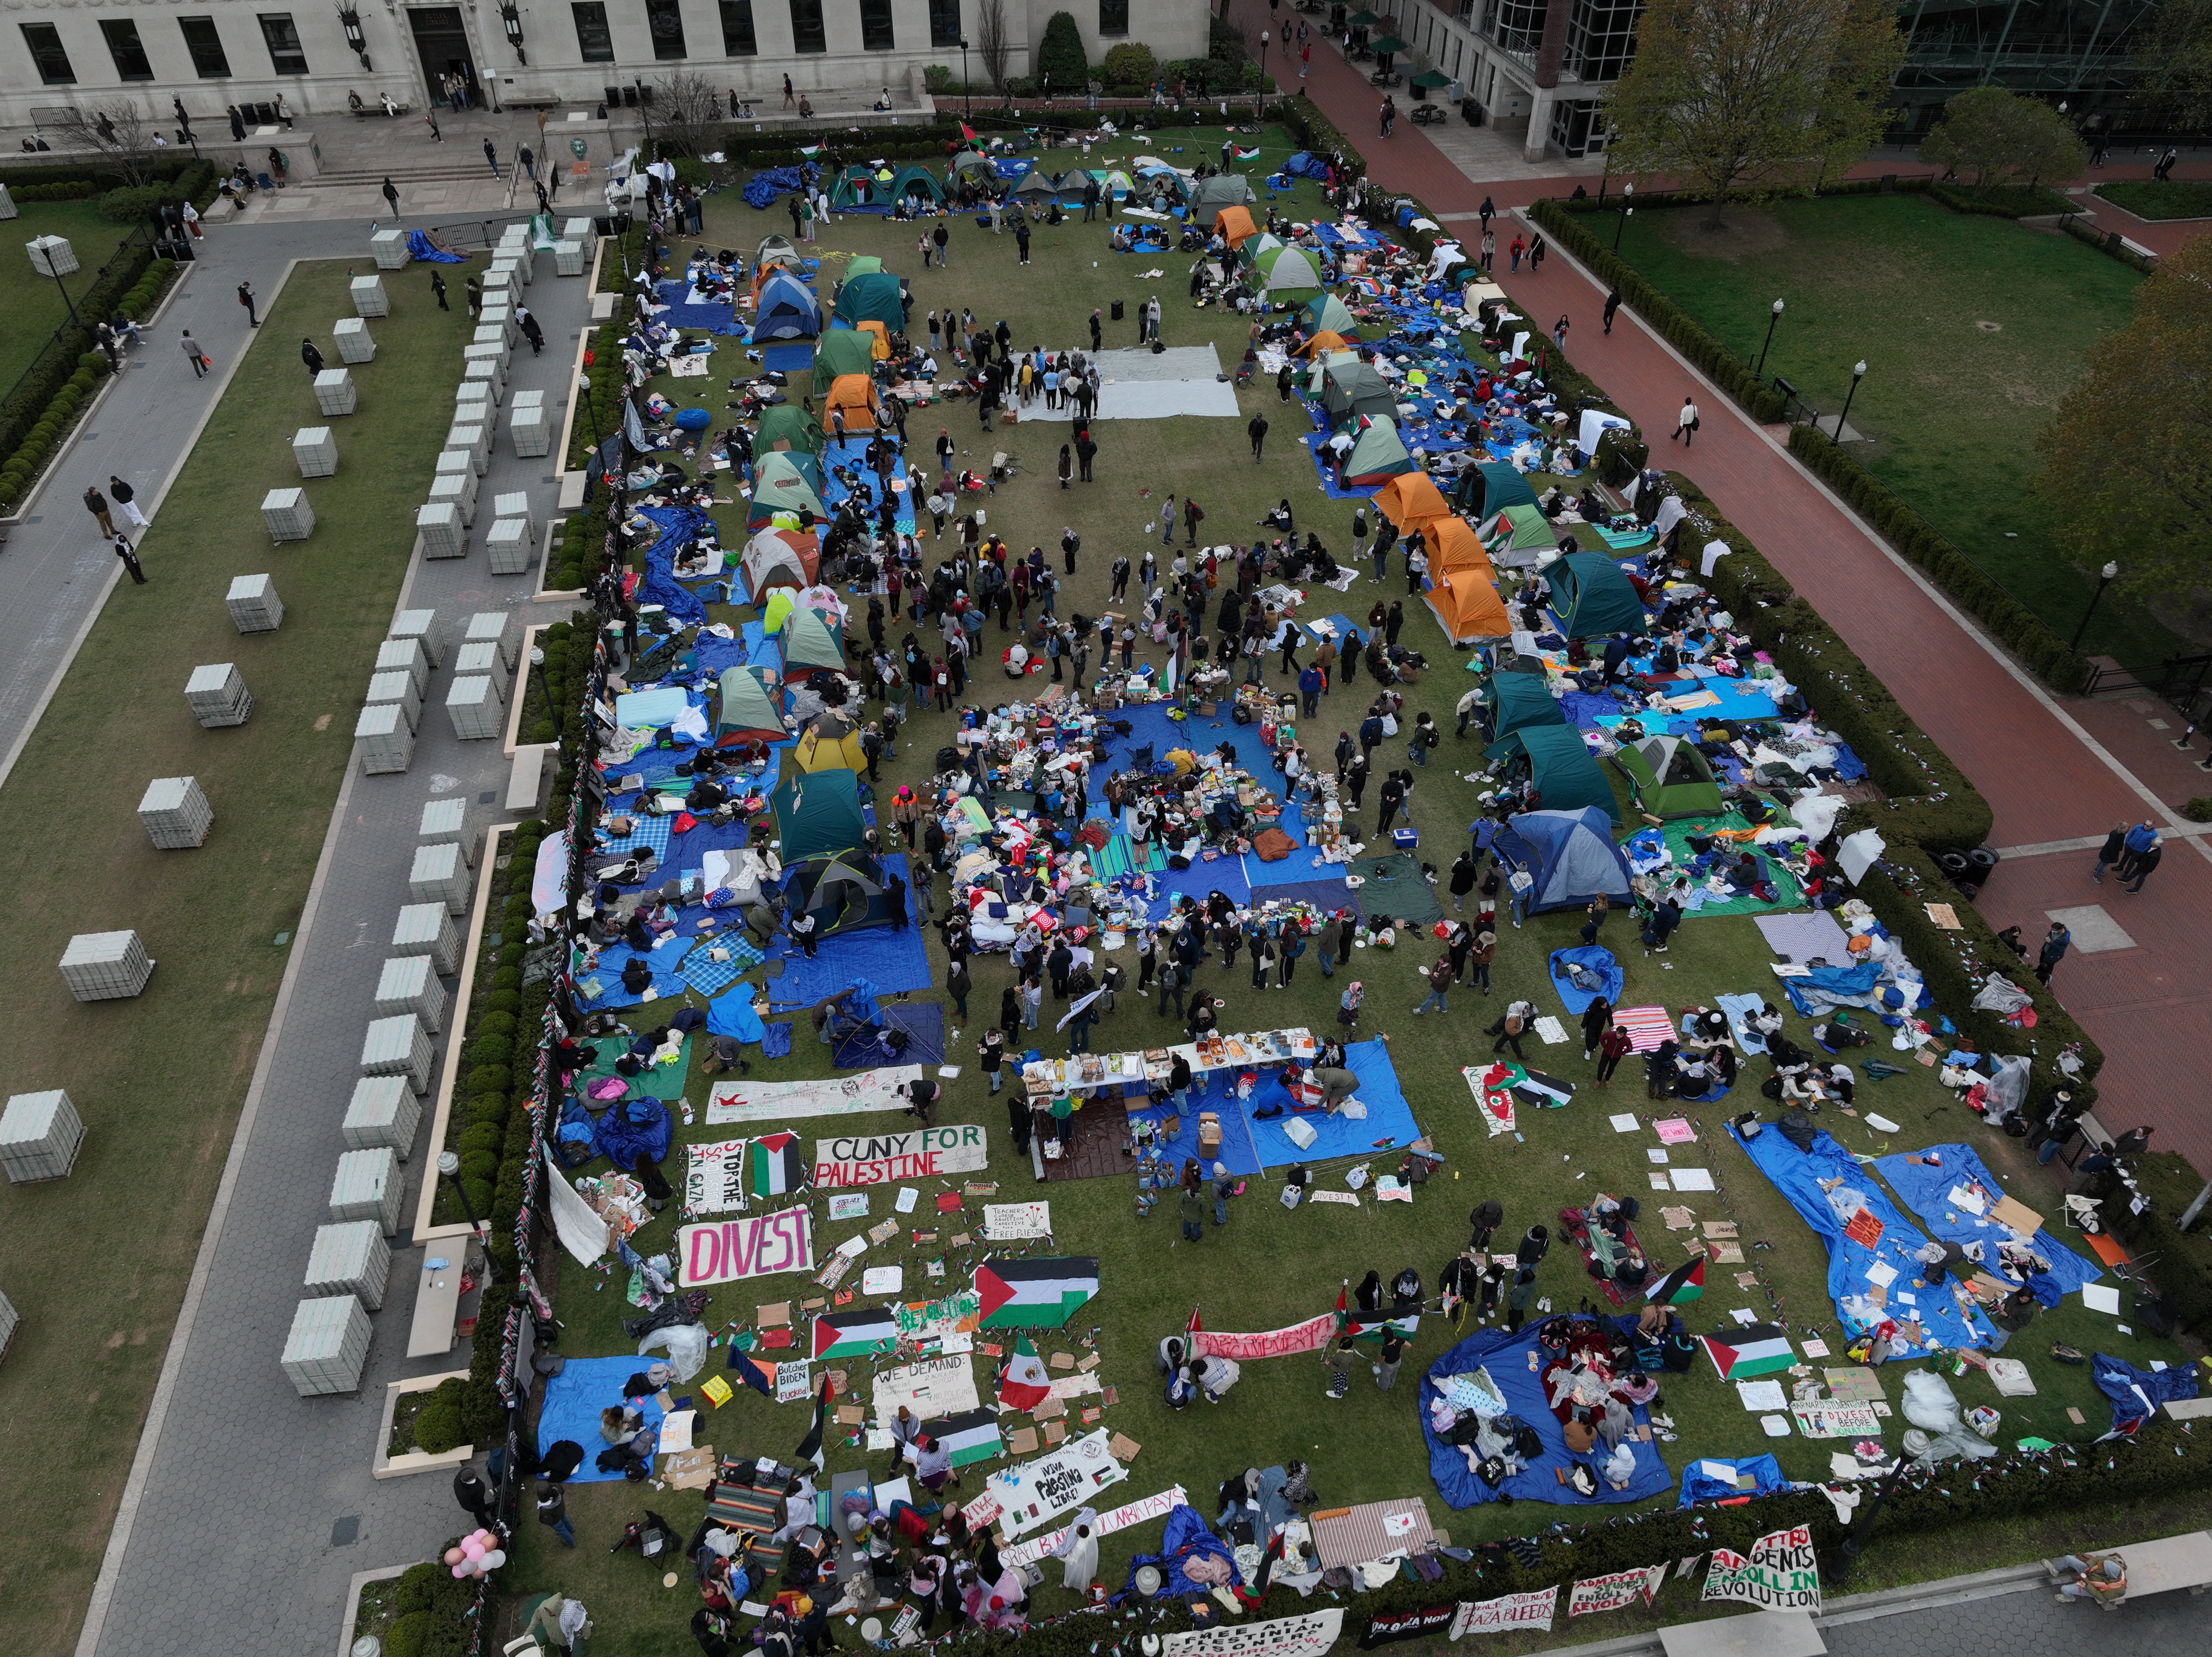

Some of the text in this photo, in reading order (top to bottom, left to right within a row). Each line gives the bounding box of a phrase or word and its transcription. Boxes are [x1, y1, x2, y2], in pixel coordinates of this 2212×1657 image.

[832, 1126, 980, 1161] CUNY FOR
[724, 1143, 743, 1204] STOP THE
[813, 1151, 943, 1187] PALESTINE
[689, 1150, 705, 1205] IN GAZA
[1676, 1176, 1711, 1185] PLEASE
[1314, 1192, 1344, 1200] DIVEST
[1379, 1189, 1411, 1200] GENOCIDE
[871, 1226, 881, 1235] ALL
[994, 1229, 1016, 1239] FREE
[1715, 1226, 1735, 1235] please
[689, 1209, 809, 1282] DIVEST
[985, 1345, 1003, 1356] STRIKE
[778, 1363, 809, 1375] Butcher
[878, 1356, 966, 1383] WE DEMAND:
[931, 1369, 960, 1380] ACADEMIC
[780, 1371, 806, 1386] BIDEN
[932, 1374, 960, 1386] BOYCOTT
[944, 1386, 973, 1397] POLICING
[942, 1396, 966, 1404] CAMPUS
[1791, 1401, 1824, 1410] BARNARD
[1826, 1400, 1857, 1409] STUDENTS
[920, 1408, 934, 1419] THE
[1828, 1410, 1873, 1420] DIVEST
[1839, 1419, 1872, 1427] BEFORE
[1050, 1487, 1080, 1509] LIBRE!
[1144, 1489, 1185, 1516] PAYS
[965, 1495, 992, 1520] VIVA
[1707, 1567, 1818, 1591] ENROLL IN
[1512, 1589, 1556, 1604] YOU READ
[1578, 1590, 1624, 1602] ENROLL
[1704, 1582, 1819, 1608] REVOLUTION
[1423, 1612, 1451, 1625] NOW
[1461, 1602, 1555, 1627] GAZA BLEEDS
[893, 1613, 910, 1634] FREE
[1185, 1617, 1313, 1644] FREE ALL
[1276, 1636, 1320, 1650] NOW
